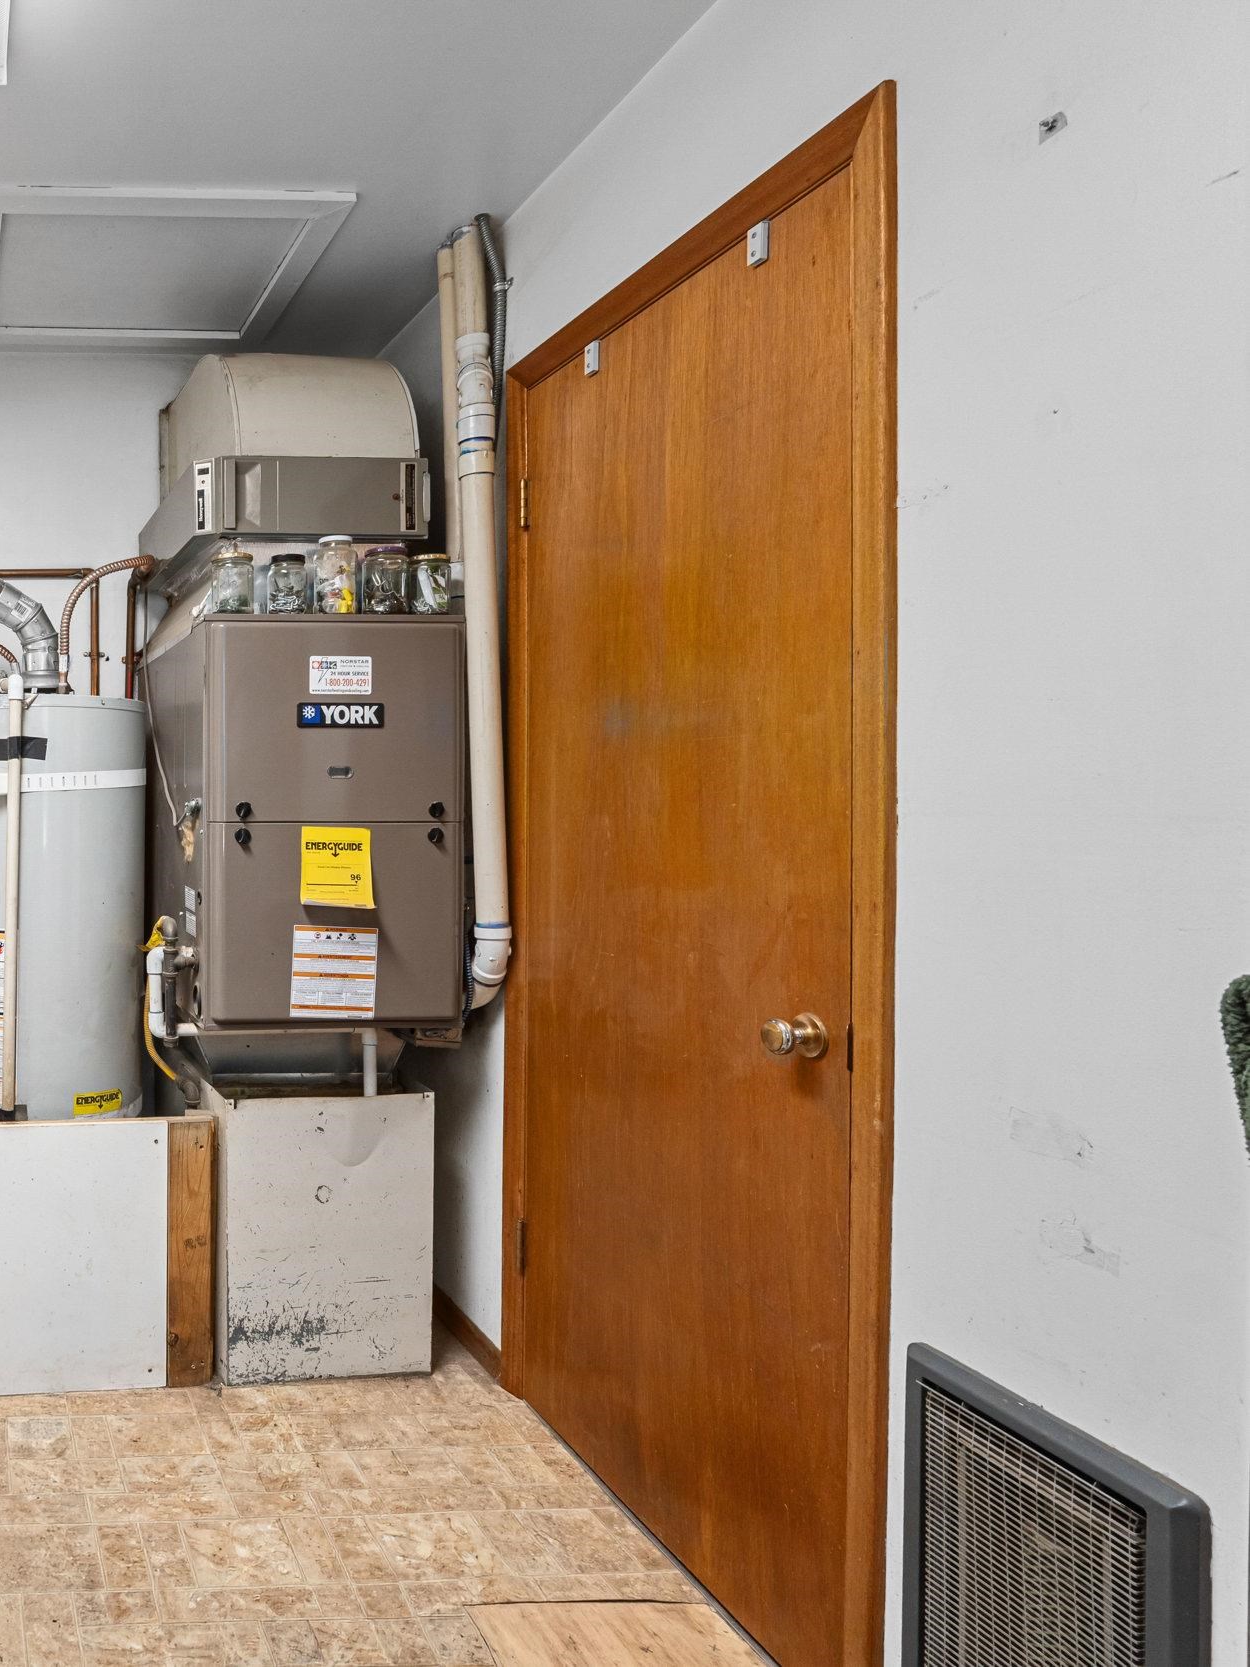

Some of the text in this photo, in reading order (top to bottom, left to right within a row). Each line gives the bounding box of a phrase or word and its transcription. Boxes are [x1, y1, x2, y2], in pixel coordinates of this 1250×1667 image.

[321, 705, 379, 724] YORK
[305, 842, 363, 853] ENERGYGUIDE
[350, 873, 362, 881] 96
[76, 1091, 120, 1106] ENERGYGUIDE
